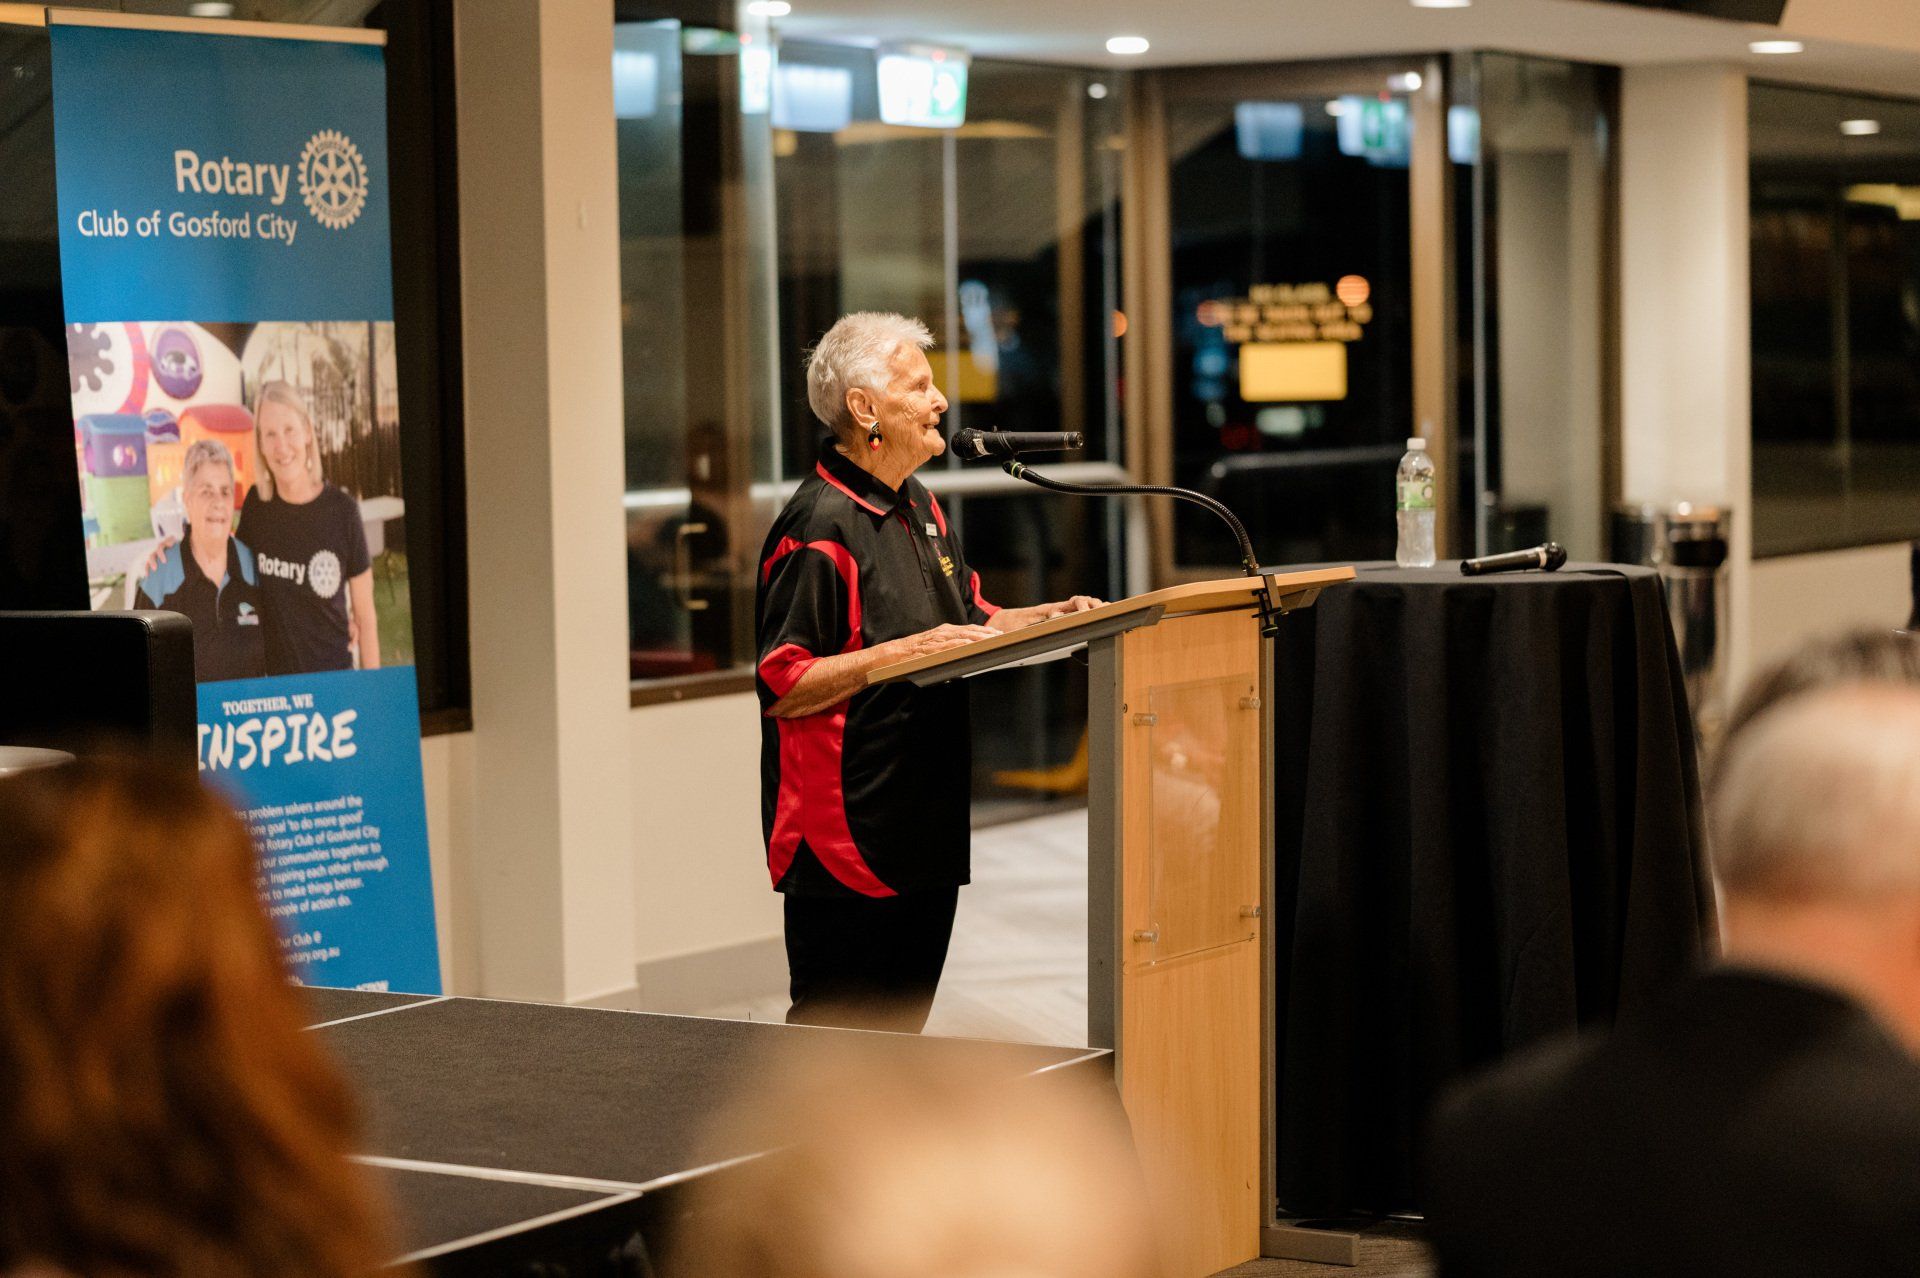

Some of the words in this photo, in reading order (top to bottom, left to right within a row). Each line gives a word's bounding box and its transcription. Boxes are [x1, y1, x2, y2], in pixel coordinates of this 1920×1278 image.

[174, 149, 290, 206] Rotary
[77, 210, 129, 238] Club
[136, 210, 161, 238] of
[168, 211, 251, 239] Gosford
[256, 213, 298, 246] City
[258, 552, 306, 586] Rotary
[222, 696, 292, 716] TOGETHER,
[292, 693, 314, 708] WE
[198, 709, 358, 772] INSPIRE
[248, 806, 283, 822] problem
[315, 797, 345, 810] around
[347, 795, 362, 807] the
[266, 838, 292, 850] Rotary
[294, 834, 313, 846] Club
[315, 831, 324, 844] of
[326, 827, 361, 842] Gosford
[362, 826, 380, 839] City
[267, 821, 285, 837] goal
[301, 817, 312, 829] do
[314, 816, 336, 827] more
[278, 850, 330, 866] communities
[331, 844, 368, 860] together
[370, 843, 381, 853] to
[306, 865, 326, 878] each
[327, 862, 351, 875] other
[352, 856, 388, 871] through
[272, 889, 281, 900] to
[283, 885, 306, 898] make
[307, 881, 333, 895] things
[270, 903, 298, 917] people
[300, 900, 309, 912] of
[311, 898, 336, 911] action
[292, 933, 312, 946] Club
[285, 947, 340, 963] rotary.org.au
